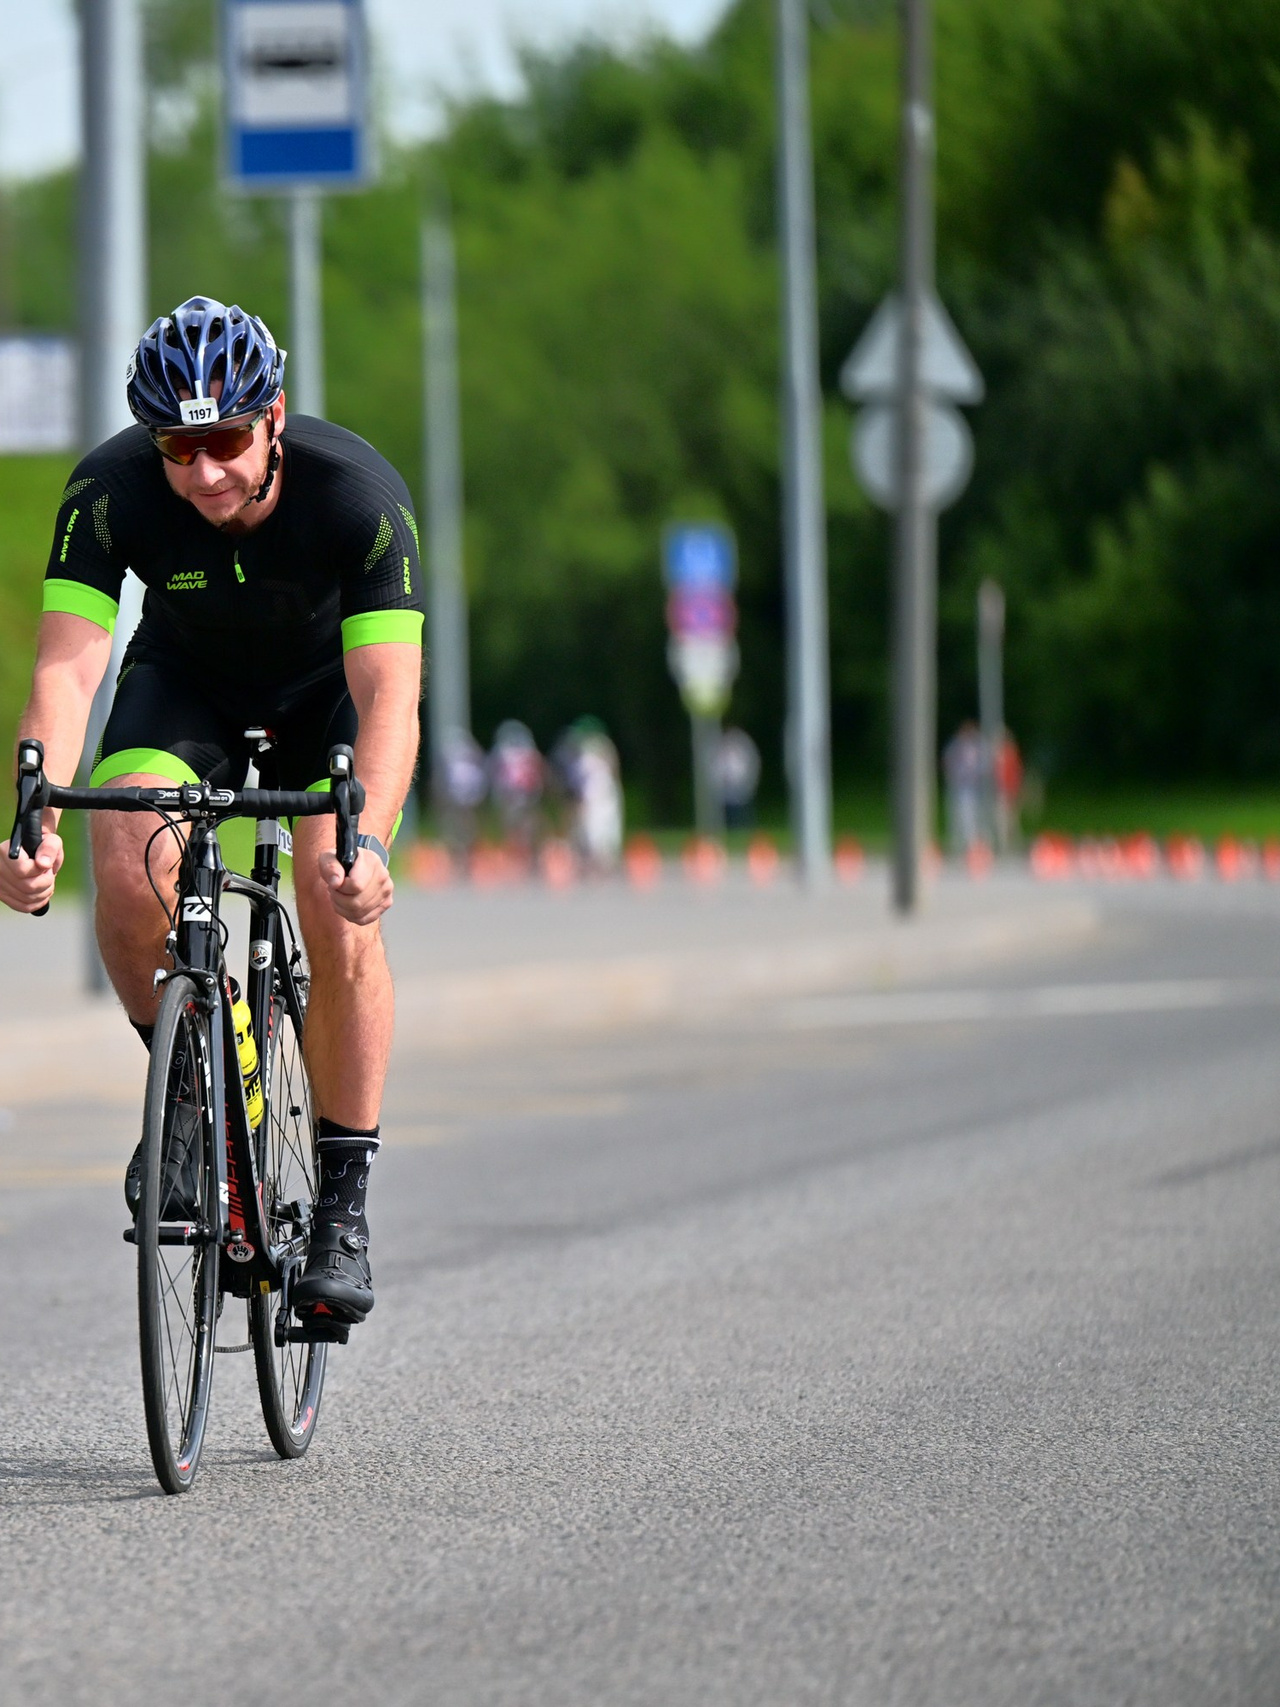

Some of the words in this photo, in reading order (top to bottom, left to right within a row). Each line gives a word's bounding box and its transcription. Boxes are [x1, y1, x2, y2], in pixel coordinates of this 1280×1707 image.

[188, 407, 212, 421] 1197
[66, 508, 80, 533] MAD
[59, 534, 71, 563] WAVE
[166, 579, 208, 591] WAVE
[171, 570, 205, 582] MAD
[402, 556, 412, 595] RACING
